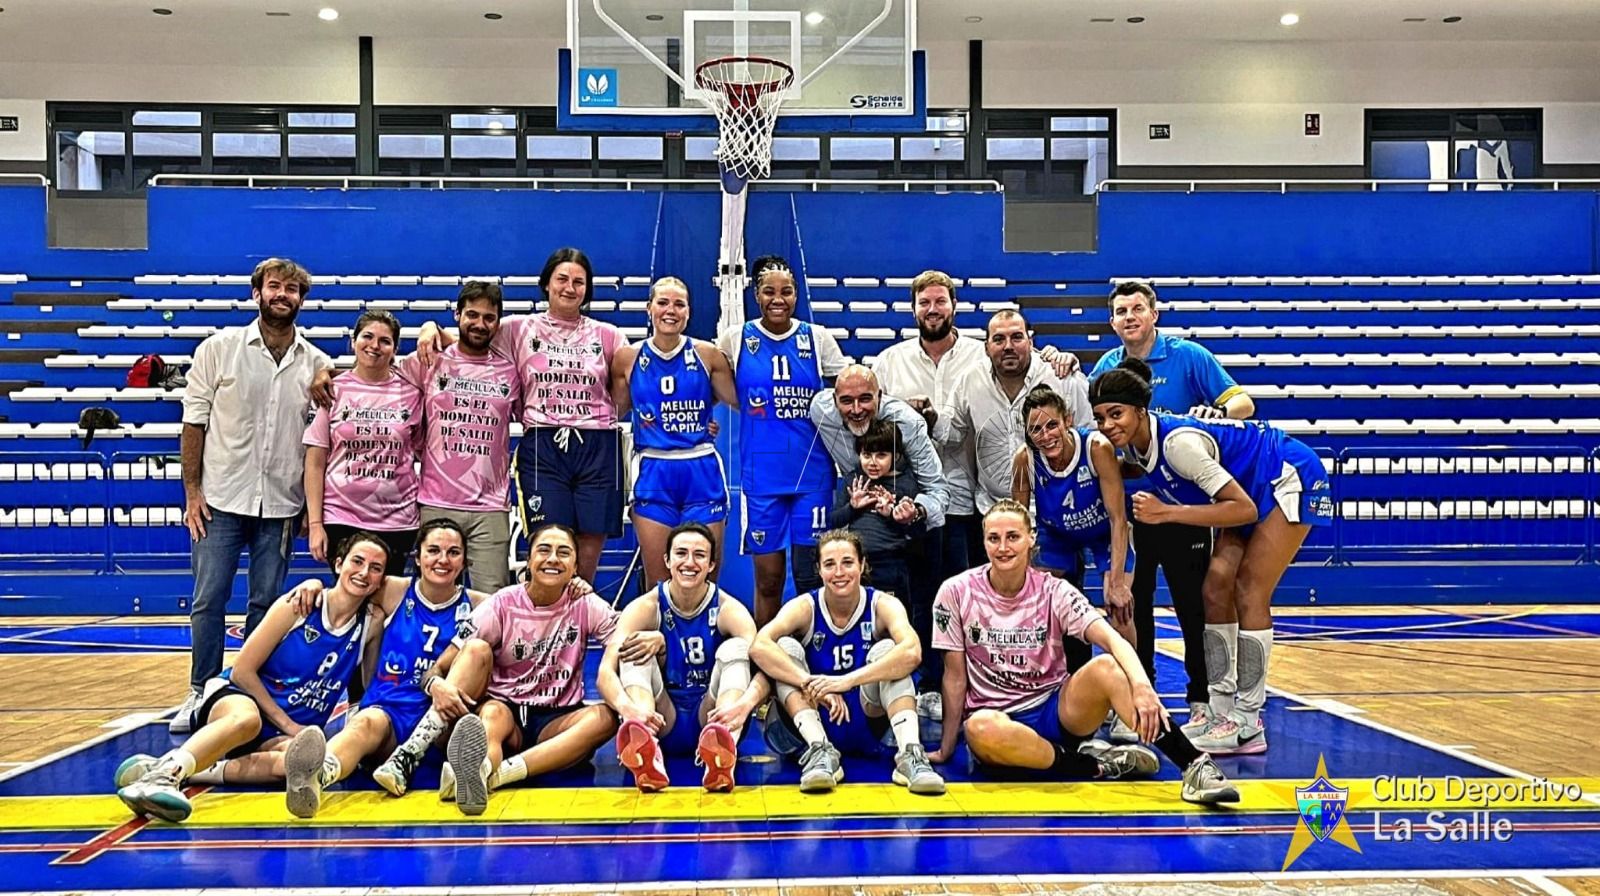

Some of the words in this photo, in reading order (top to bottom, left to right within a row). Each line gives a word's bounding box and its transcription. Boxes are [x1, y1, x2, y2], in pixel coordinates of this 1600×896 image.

[547, 345, 588, 355] MELILLA
[548, 359, 564, 367] ES
[568, 360, 585, 370] EL
[771, 354, 791, 380] 11
[534, 372, 597, 386] MOMENTO
[660, 375, 675, 395] 0
[454, 381, 497, 393] MELILLA
[537, 388, 552, 399] DE
[556, 388, 592, 401] SALIR
[454, 397, 469, 407] ES
[473, 399, 488, 410] EL
[540, 404, 546, 414] A
[550, 404, 591, 415] JUGAR
[660, 399, 705, 412] MELILLA
[356, 410, 397, 420] MELILLA
[439, 411, 499, 427] MOMENTO
[661, 411, 699, 423] SPORT
[356, 426, 371, 436] ES
[376, 427, 391, 436] EL
[441, 426, 455, 437] DE
[458, 428, 494, 441] SALIR
[341, 440, 402, 451] MOMENTO
[442, 441, 448, 451] A
[451, 443, 490, 456] JUGAR
[345, 453, 360, 462] DE
[362, 454, 398, 465] SALIR
[354, 468, 395, 480] JUGAR
[1062, 489, 1075, 510] 4
[1063, 498, 1103, 521] MELILLA
[812, 506, 826, 529] 11
[1064, 508, 1098, 527] SPORT
[422, 623, 439, 652] 7
[987, 631, 1033, 644] MELILLA
[833, 644, 854, 671] 15
[990, 653, 1005, 665] ES
[1010, 654, 1027, 666] EL
